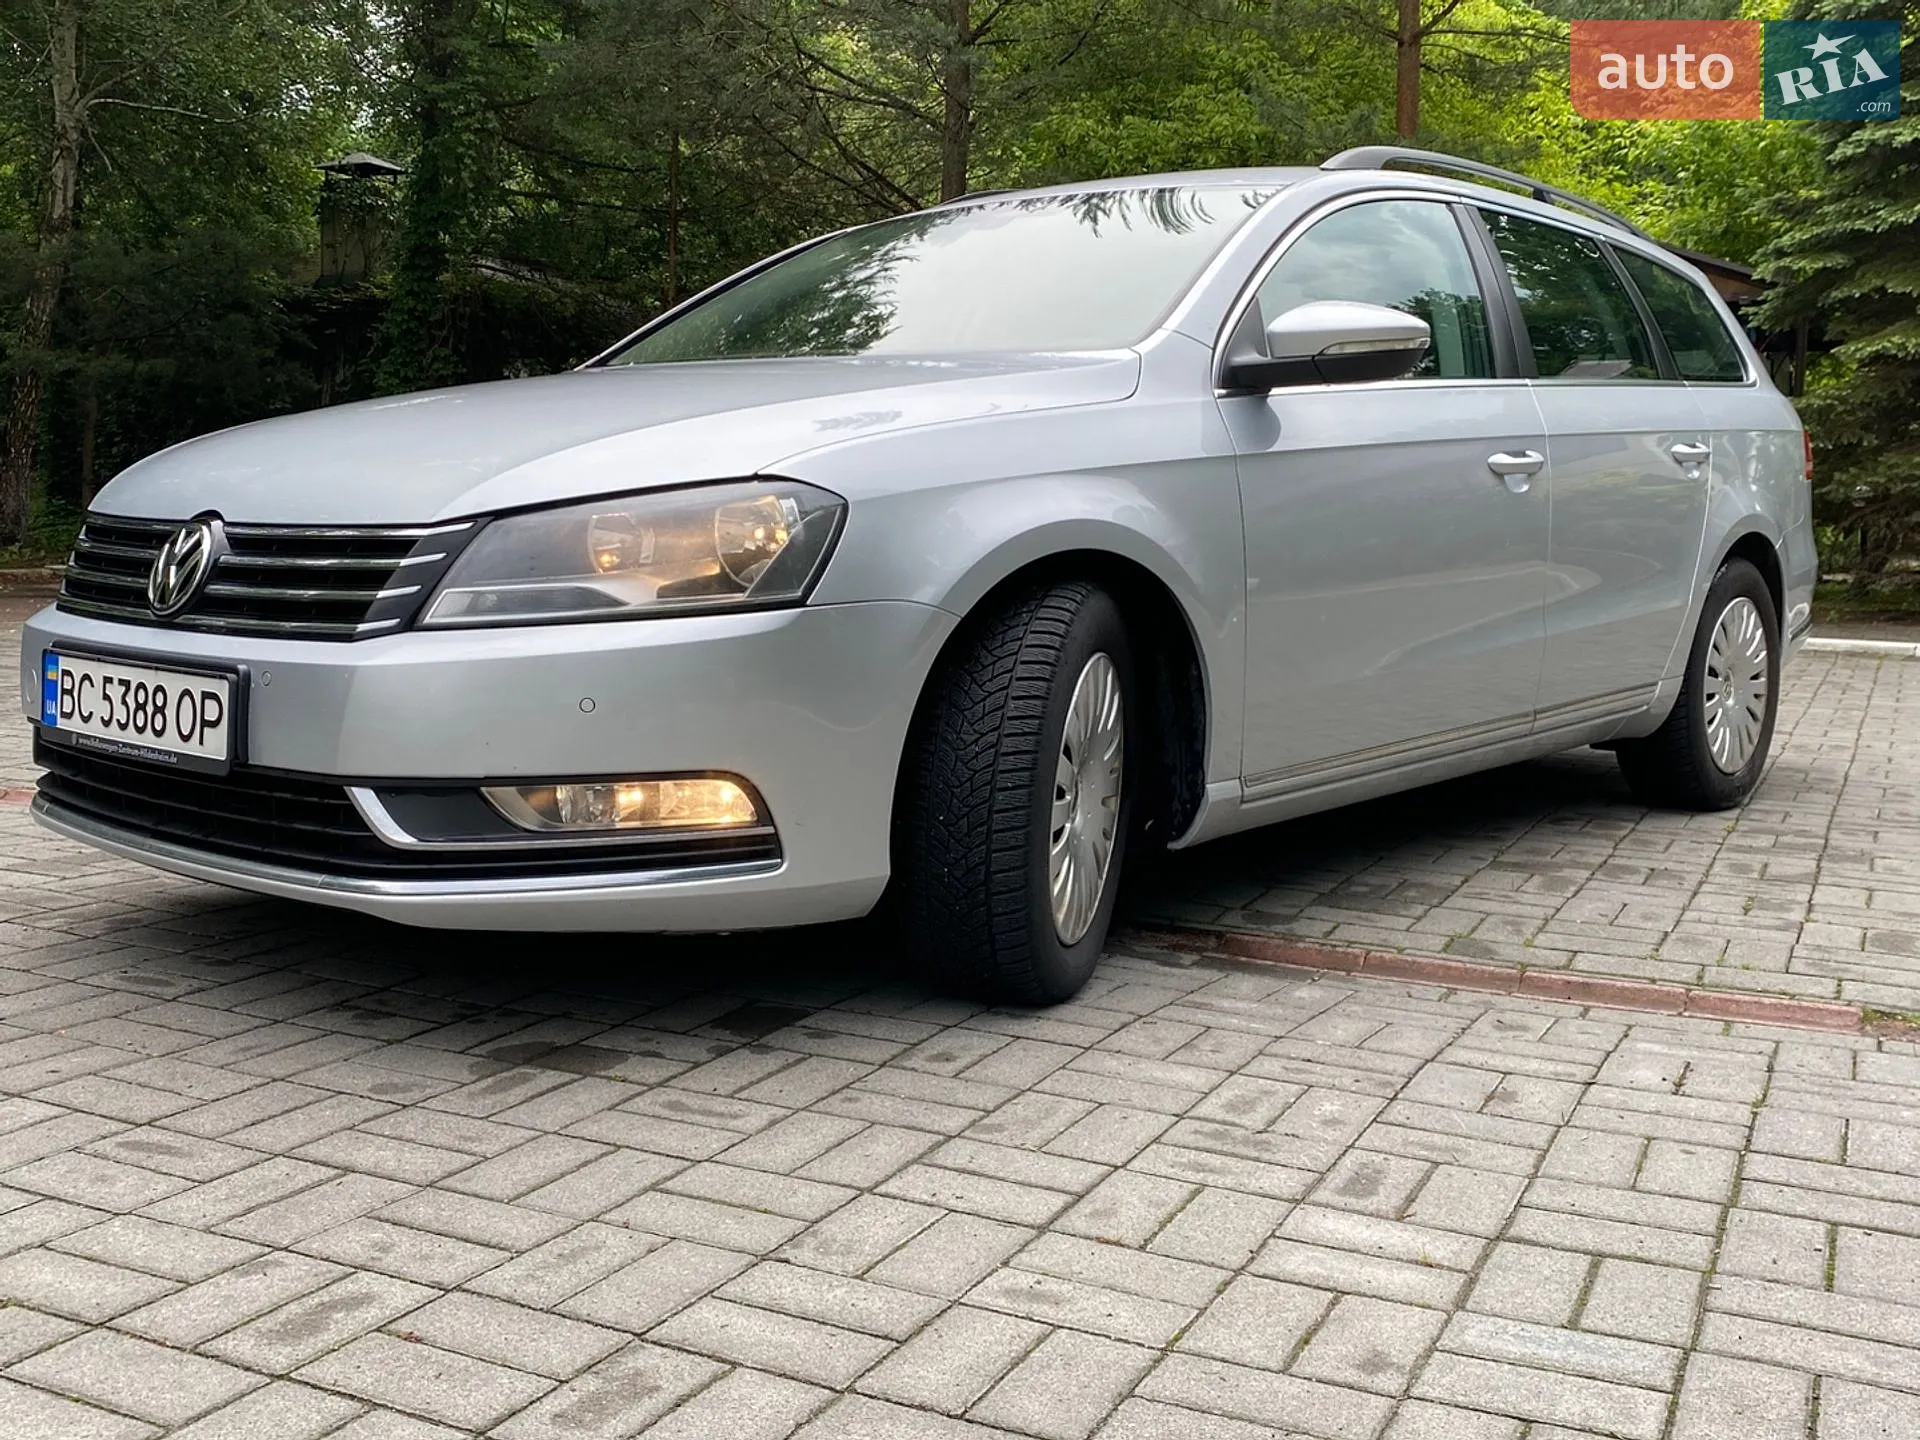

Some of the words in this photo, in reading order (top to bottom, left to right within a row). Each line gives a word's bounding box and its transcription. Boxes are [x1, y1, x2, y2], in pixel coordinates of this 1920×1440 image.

[46, 699, 57, 715] UA
[60, 668, 95, 724] BC
[100, 675, 168, 738] 5388
[175, 687, 224, 746] OP
